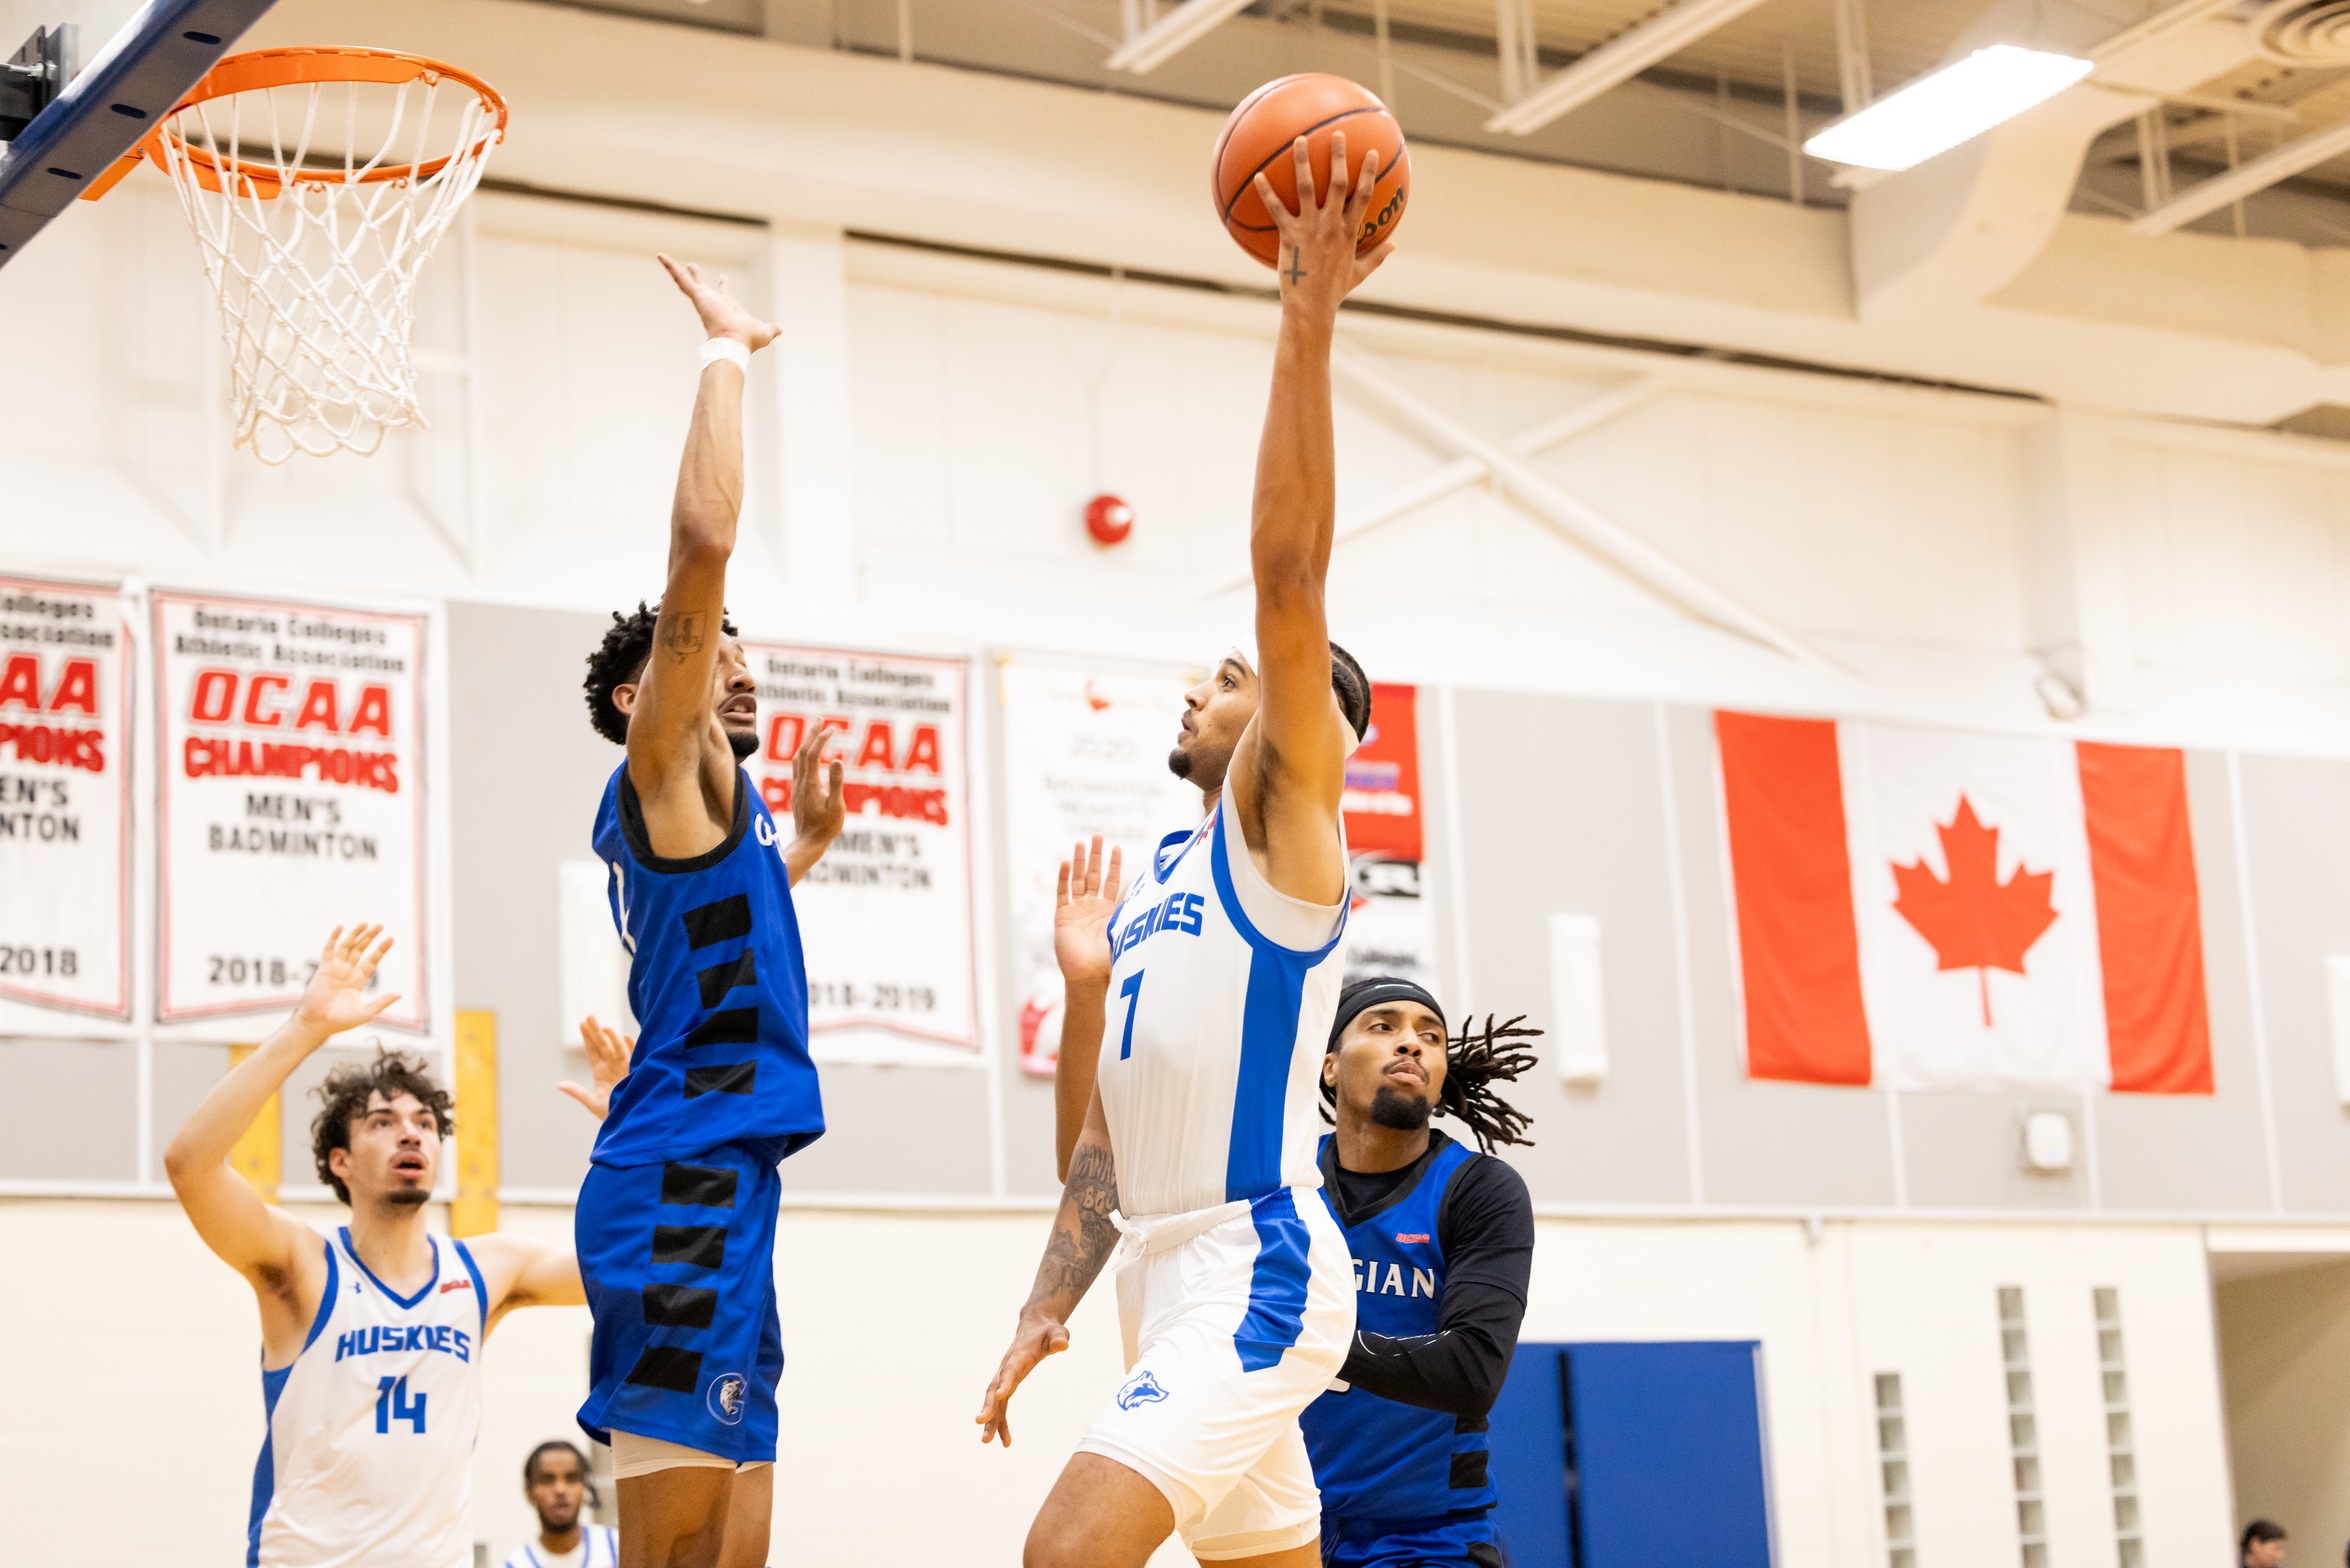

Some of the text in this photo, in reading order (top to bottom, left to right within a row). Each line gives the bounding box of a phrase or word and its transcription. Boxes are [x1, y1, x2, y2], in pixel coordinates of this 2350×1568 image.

[190, 670, 392, 737] OCAA
[184, 736, 399, 794] CHAMPIONS
[246, 794, 341, 823] MEN'S
[209, 824, 378, 861] BADMINTON
[1112, 892, 1205, 967] USKIES
[0, 947, 77, 975] 2018
[808, 982, 936, 1010] 018-2019
[334, 1325, 471, 1363] HUSKIES
[376, 1375, 427, 1434] 14
